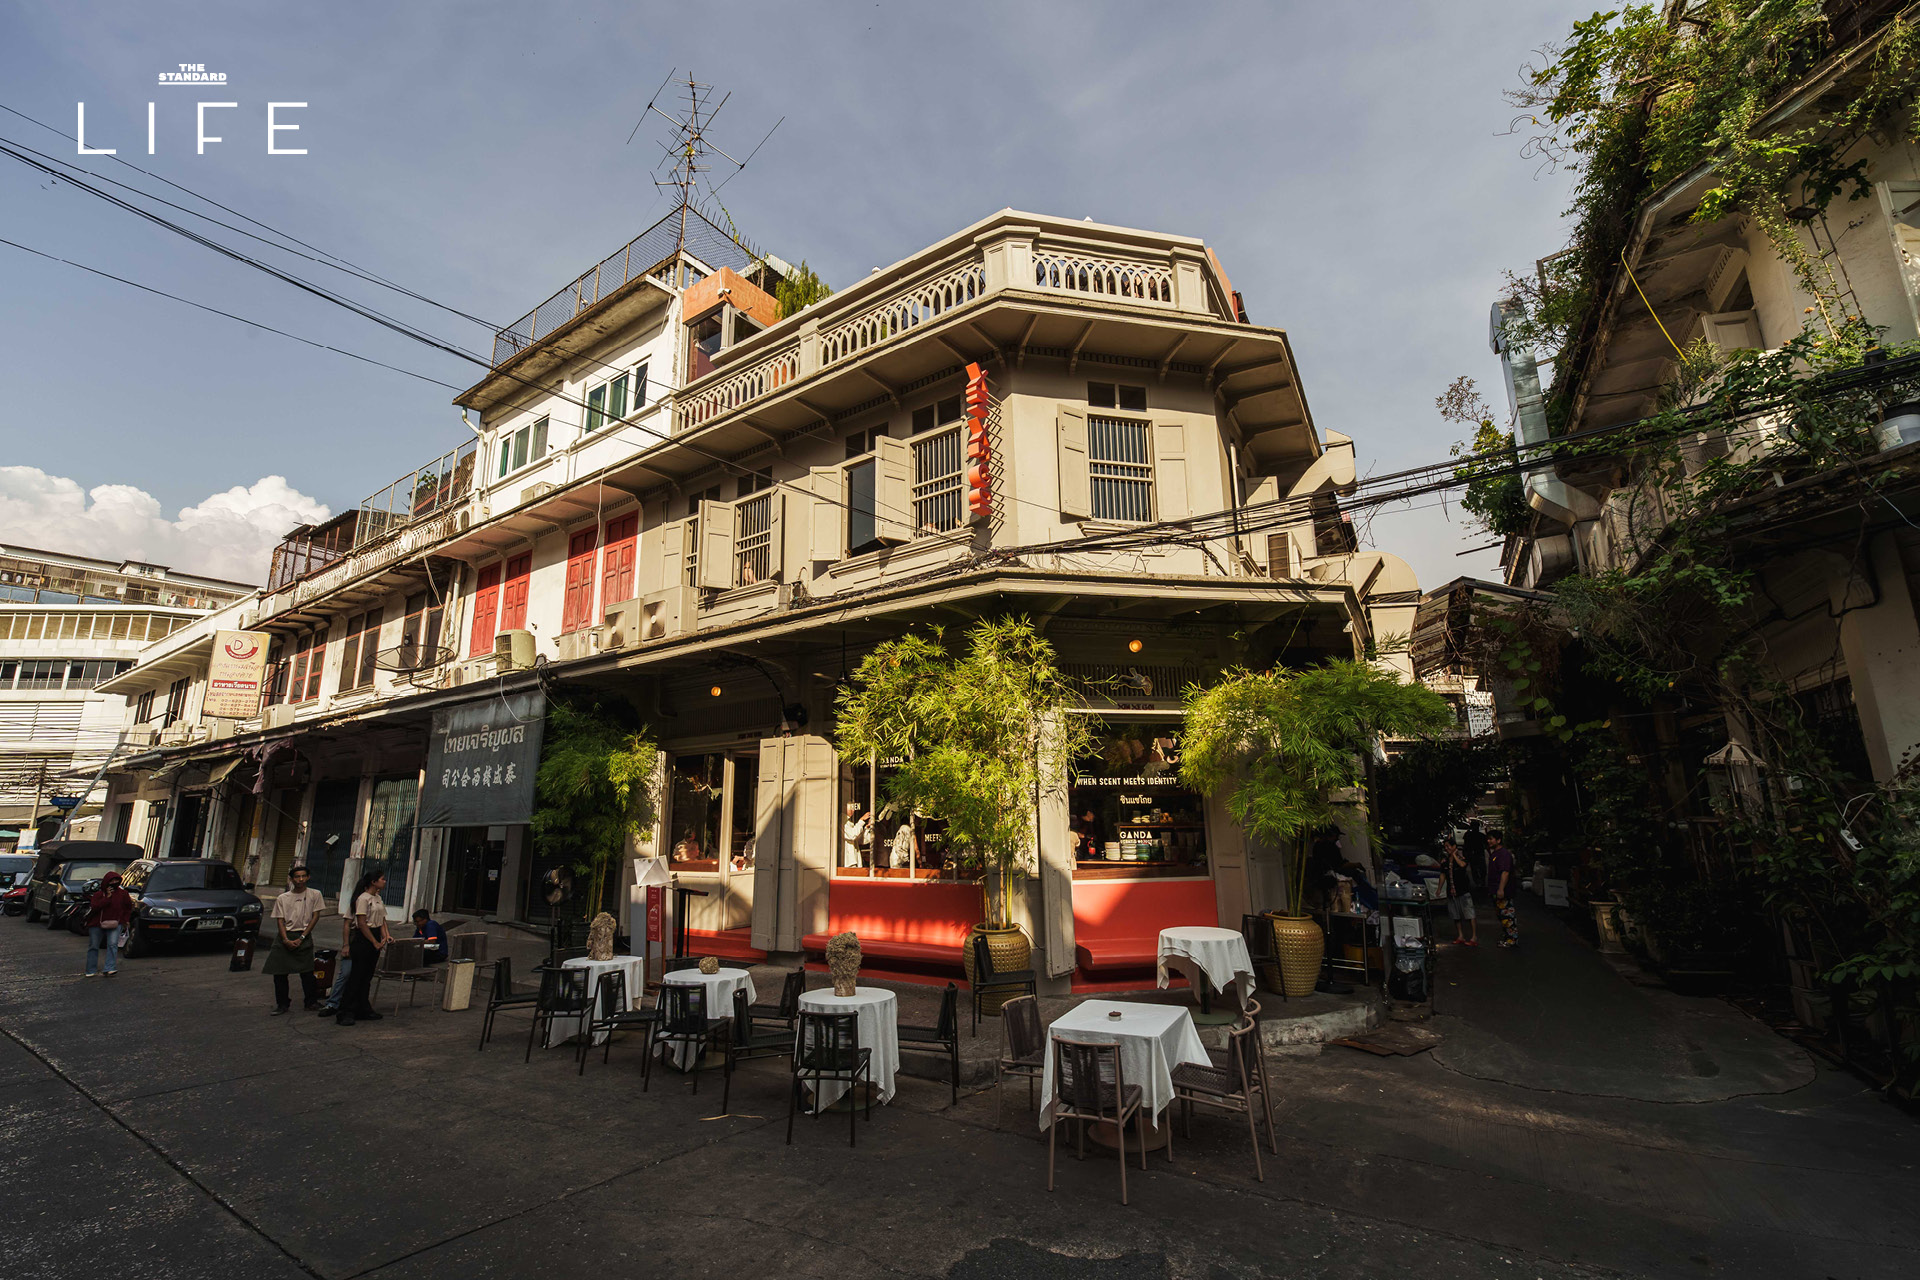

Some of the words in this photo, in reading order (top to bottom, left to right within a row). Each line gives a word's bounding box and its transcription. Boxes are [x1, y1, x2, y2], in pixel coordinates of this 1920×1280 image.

[438, 724, 525, 754] ไทยเจริญผล
[1077, 777, 1097, 786] WHEN
[1099, 777, 1121, 786] SCENT
[1123, 777, 1145, 786] MEETS
[1147, 777, 1177, 785] IDENTITY
[924, 833, 942, 842] MEETS
[1120, 830, 1153, 839] GANDA
